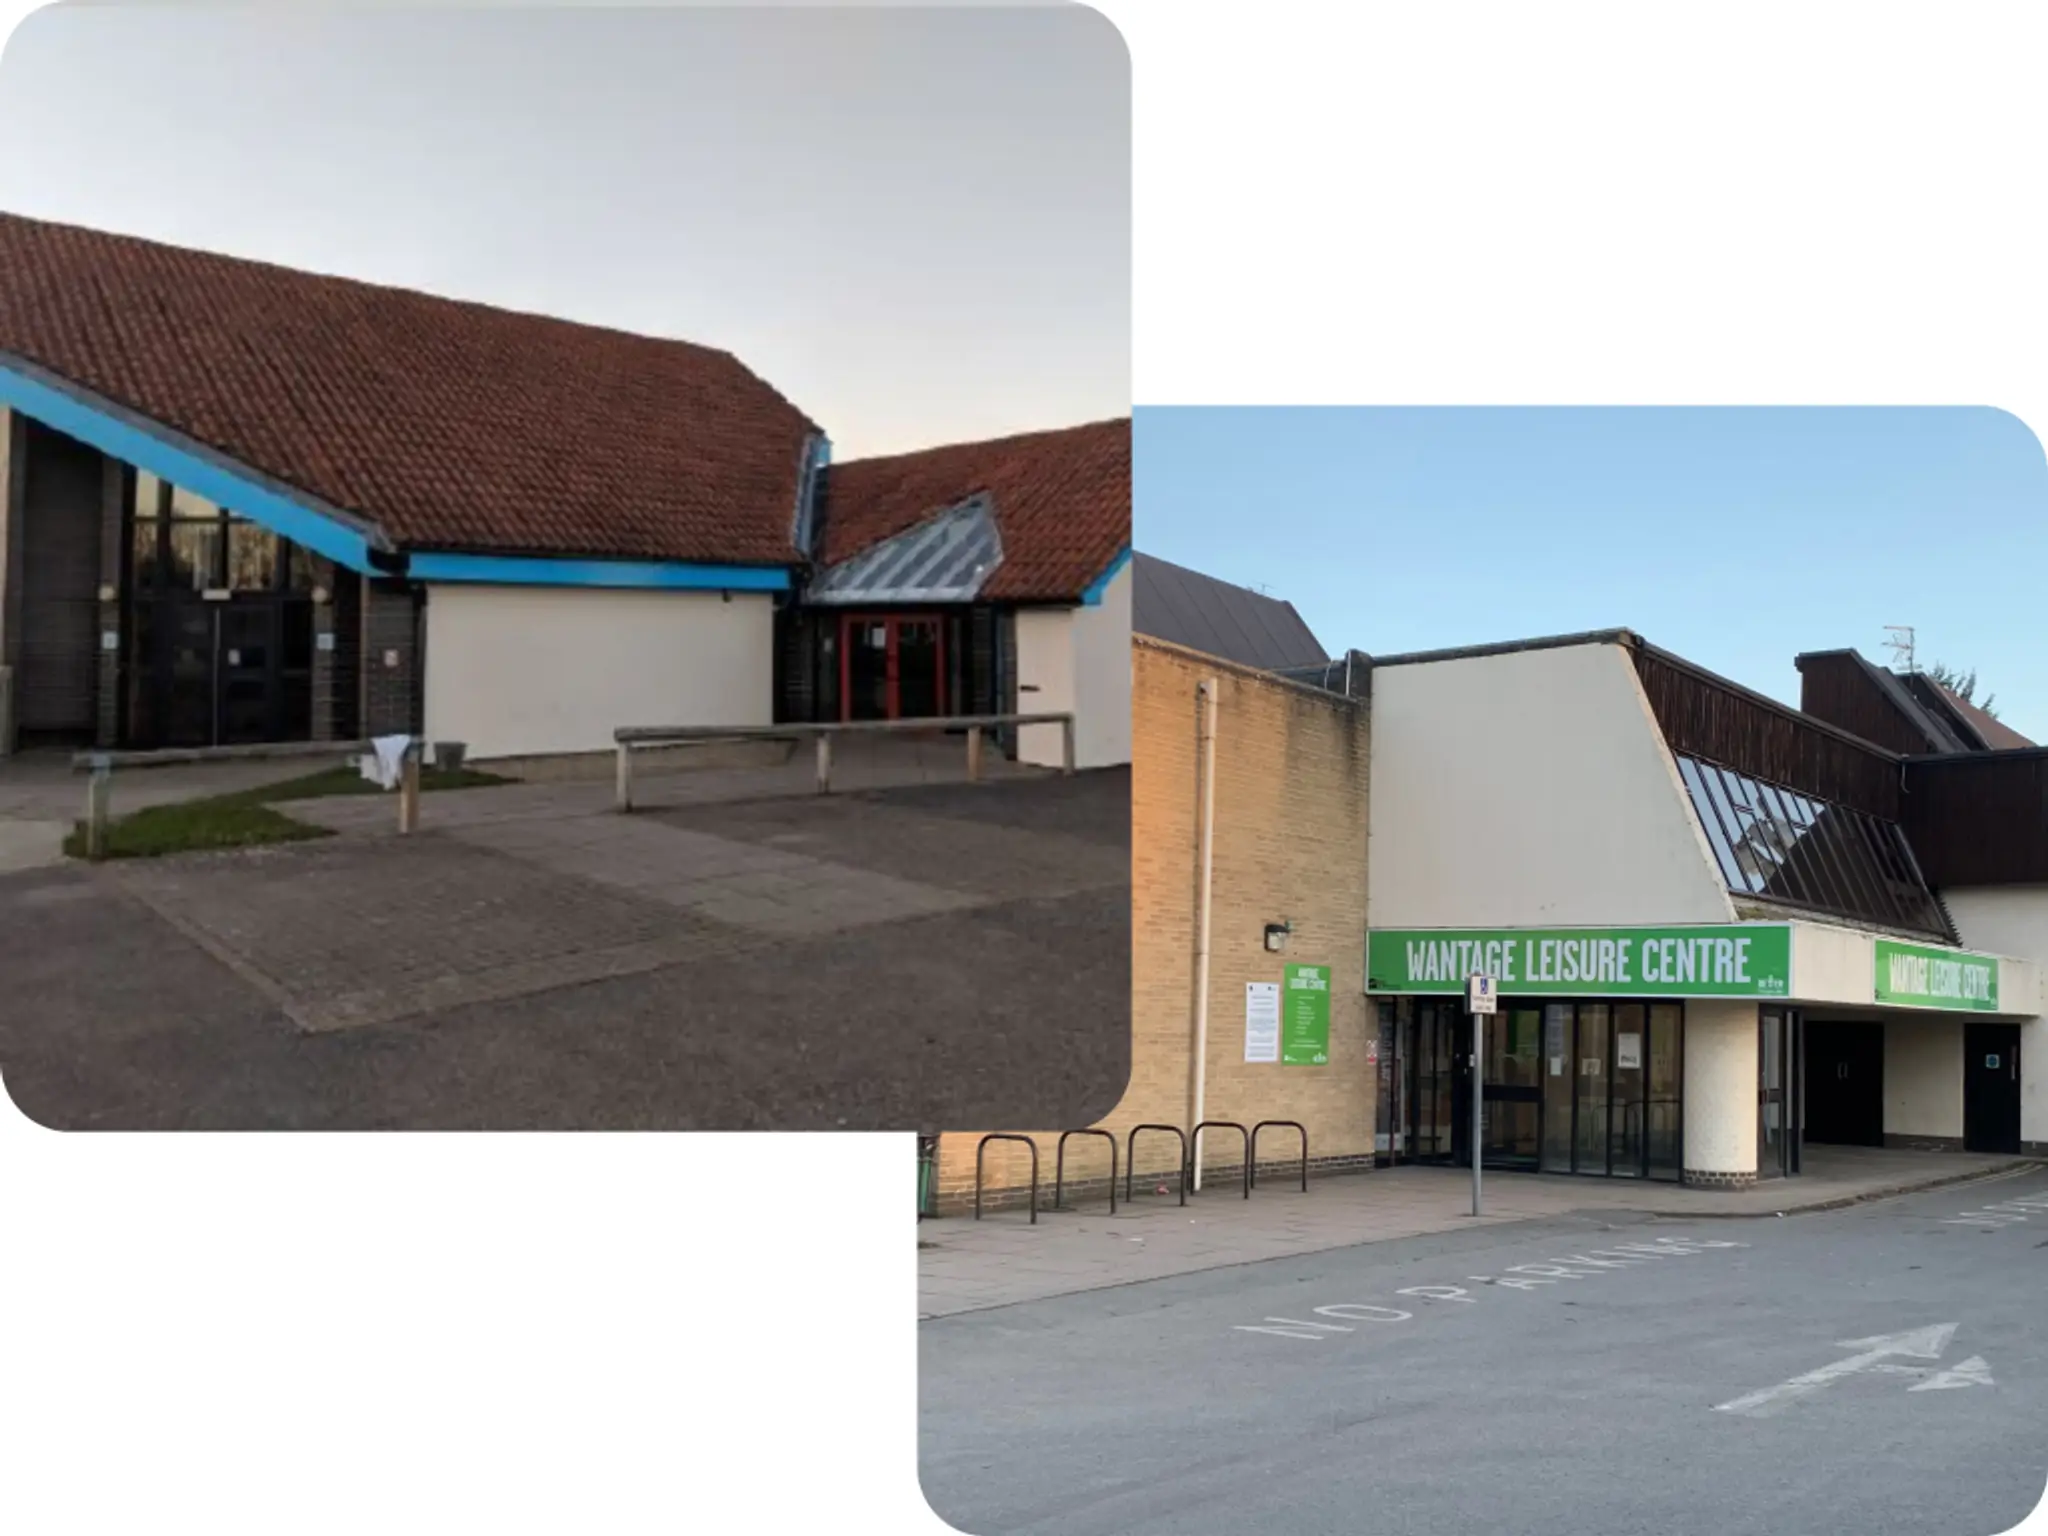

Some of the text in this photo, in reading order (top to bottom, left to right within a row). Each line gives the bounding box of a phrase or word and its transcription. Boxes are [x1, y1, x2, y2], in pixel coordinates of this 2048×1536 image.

[1406, 938, 1751, 982] WANTAGE LEISURE CENTRE
[1233, 1236, 1752, 1340] NO PARKING
